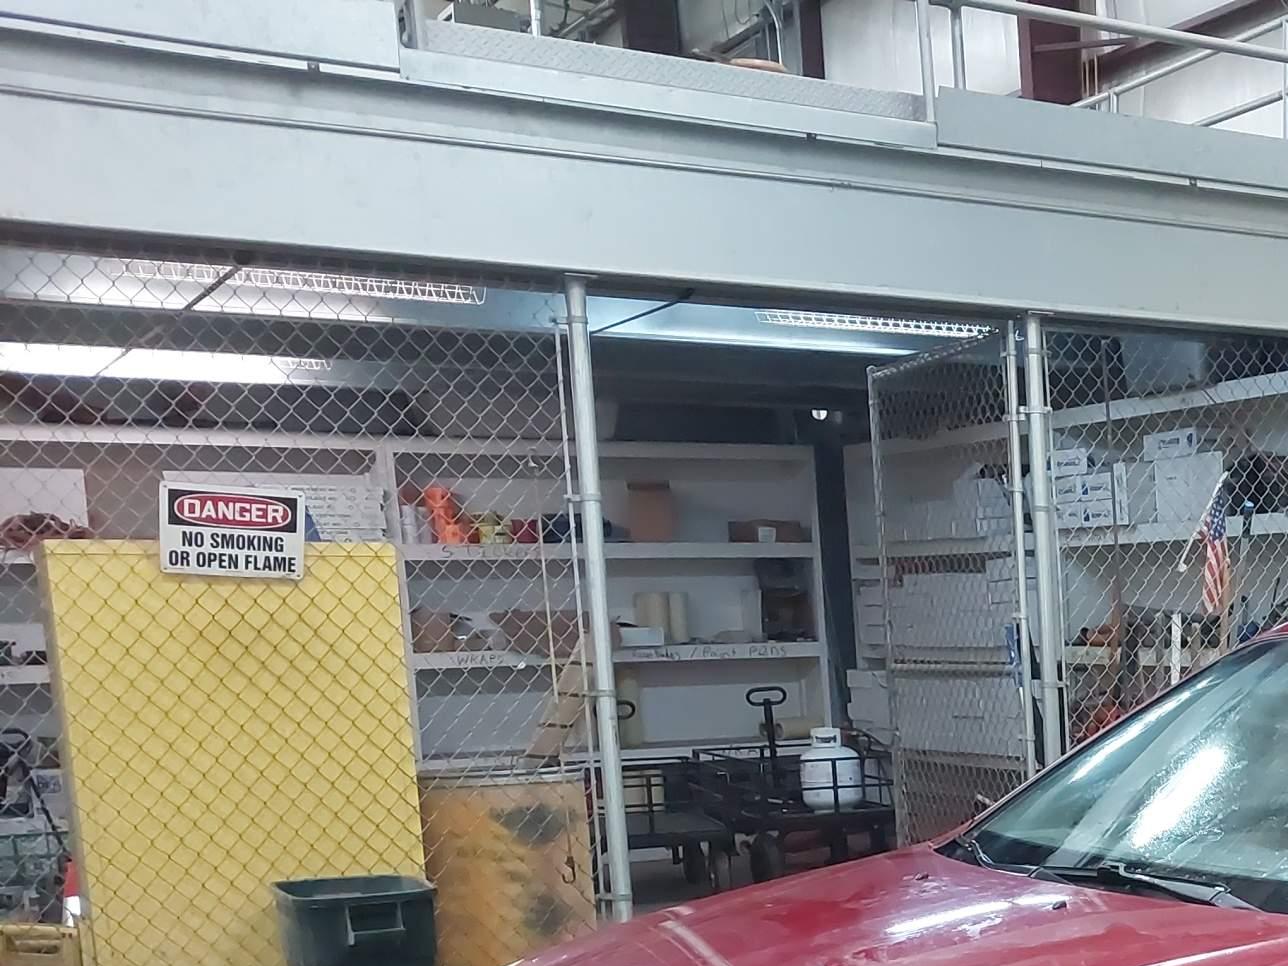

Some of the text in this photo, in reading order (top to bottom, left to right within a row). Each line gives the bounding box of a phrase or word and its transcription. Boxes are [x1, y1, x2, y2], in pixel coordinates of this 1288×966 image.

[183, 498, 284, 524] DANGER
[181, 530, 285, 552] NO SMOKING
[168, 550, 297, 573] OR OPEN FLAME
